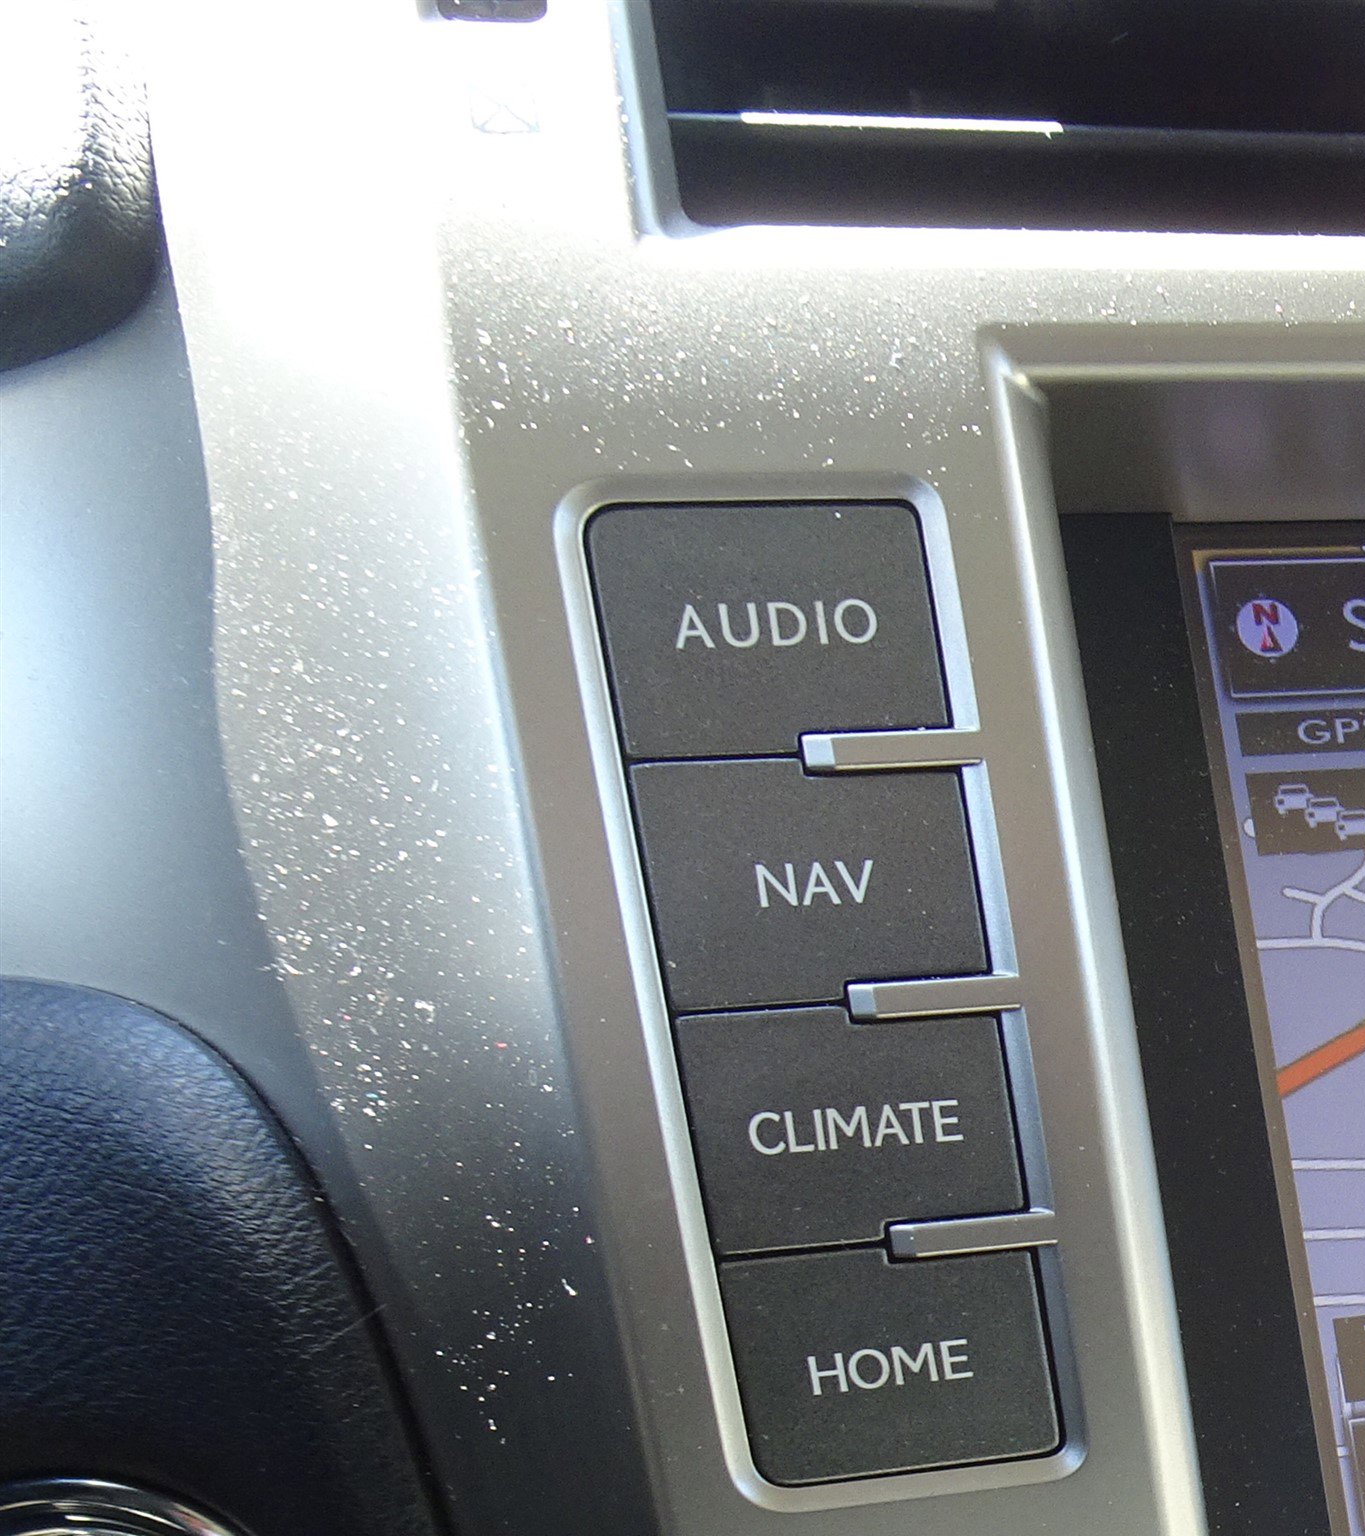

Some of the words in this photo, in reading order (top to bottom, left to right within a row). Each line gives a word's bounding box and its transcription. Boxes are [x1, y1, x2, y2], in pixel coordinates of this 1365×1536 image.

[675, 599, 877, 649] AUDIO
[755, 860, 874, 907] NAV
[748, 1099, 963, 1155] CLIMATE
[808, 1338, 973, 1395] HOME
